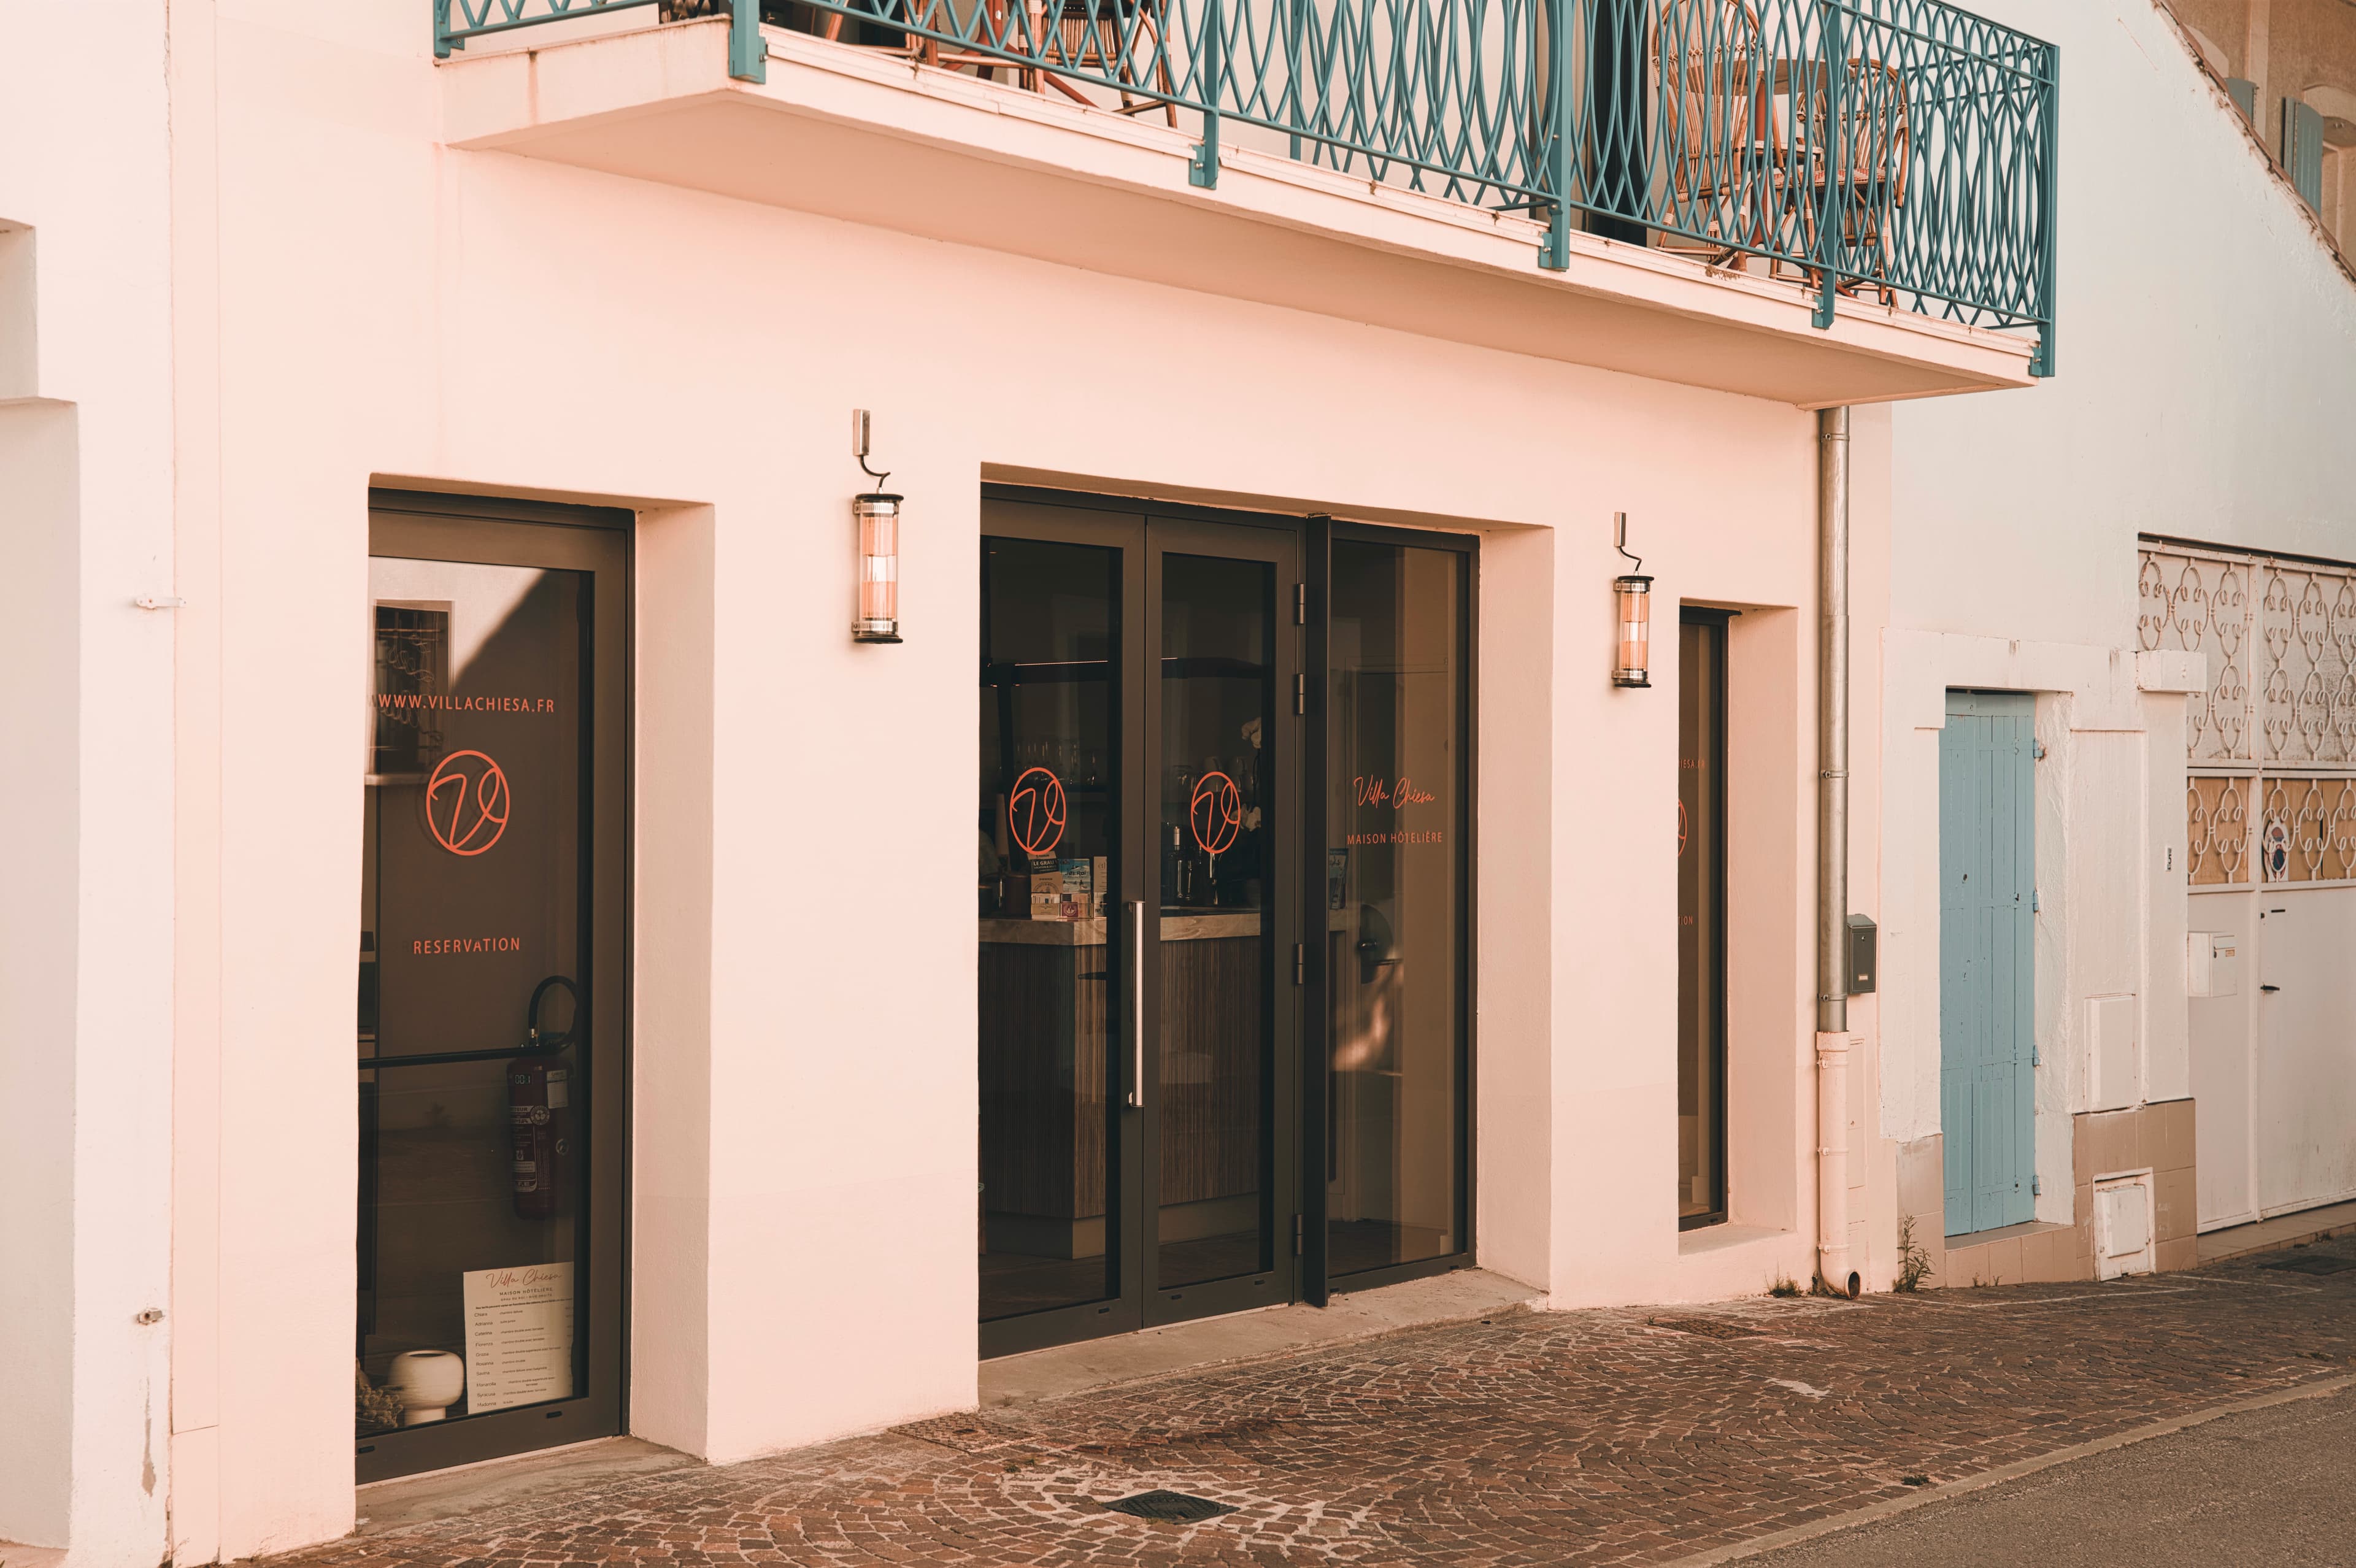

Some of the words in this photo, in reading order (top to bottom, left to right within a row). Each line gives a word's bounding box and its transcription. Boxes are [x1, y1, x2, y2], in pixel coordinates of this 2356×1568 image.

[378, 694, 555, 712] WWW.VILLACHIESA.FR
[1353, 774, 1390, 809] Villa
[1392, 777, 1435, 809] Chiesa
[1347, 834, 1386, 845] MAISON
[1390, 830, 1442, 844] HÔTELIÈRE
[414, 937, 520, 955] RESERVATION
[486, 1271, 519, 1288] Villa
[522, 1269, 563, 1286] Chiesa
